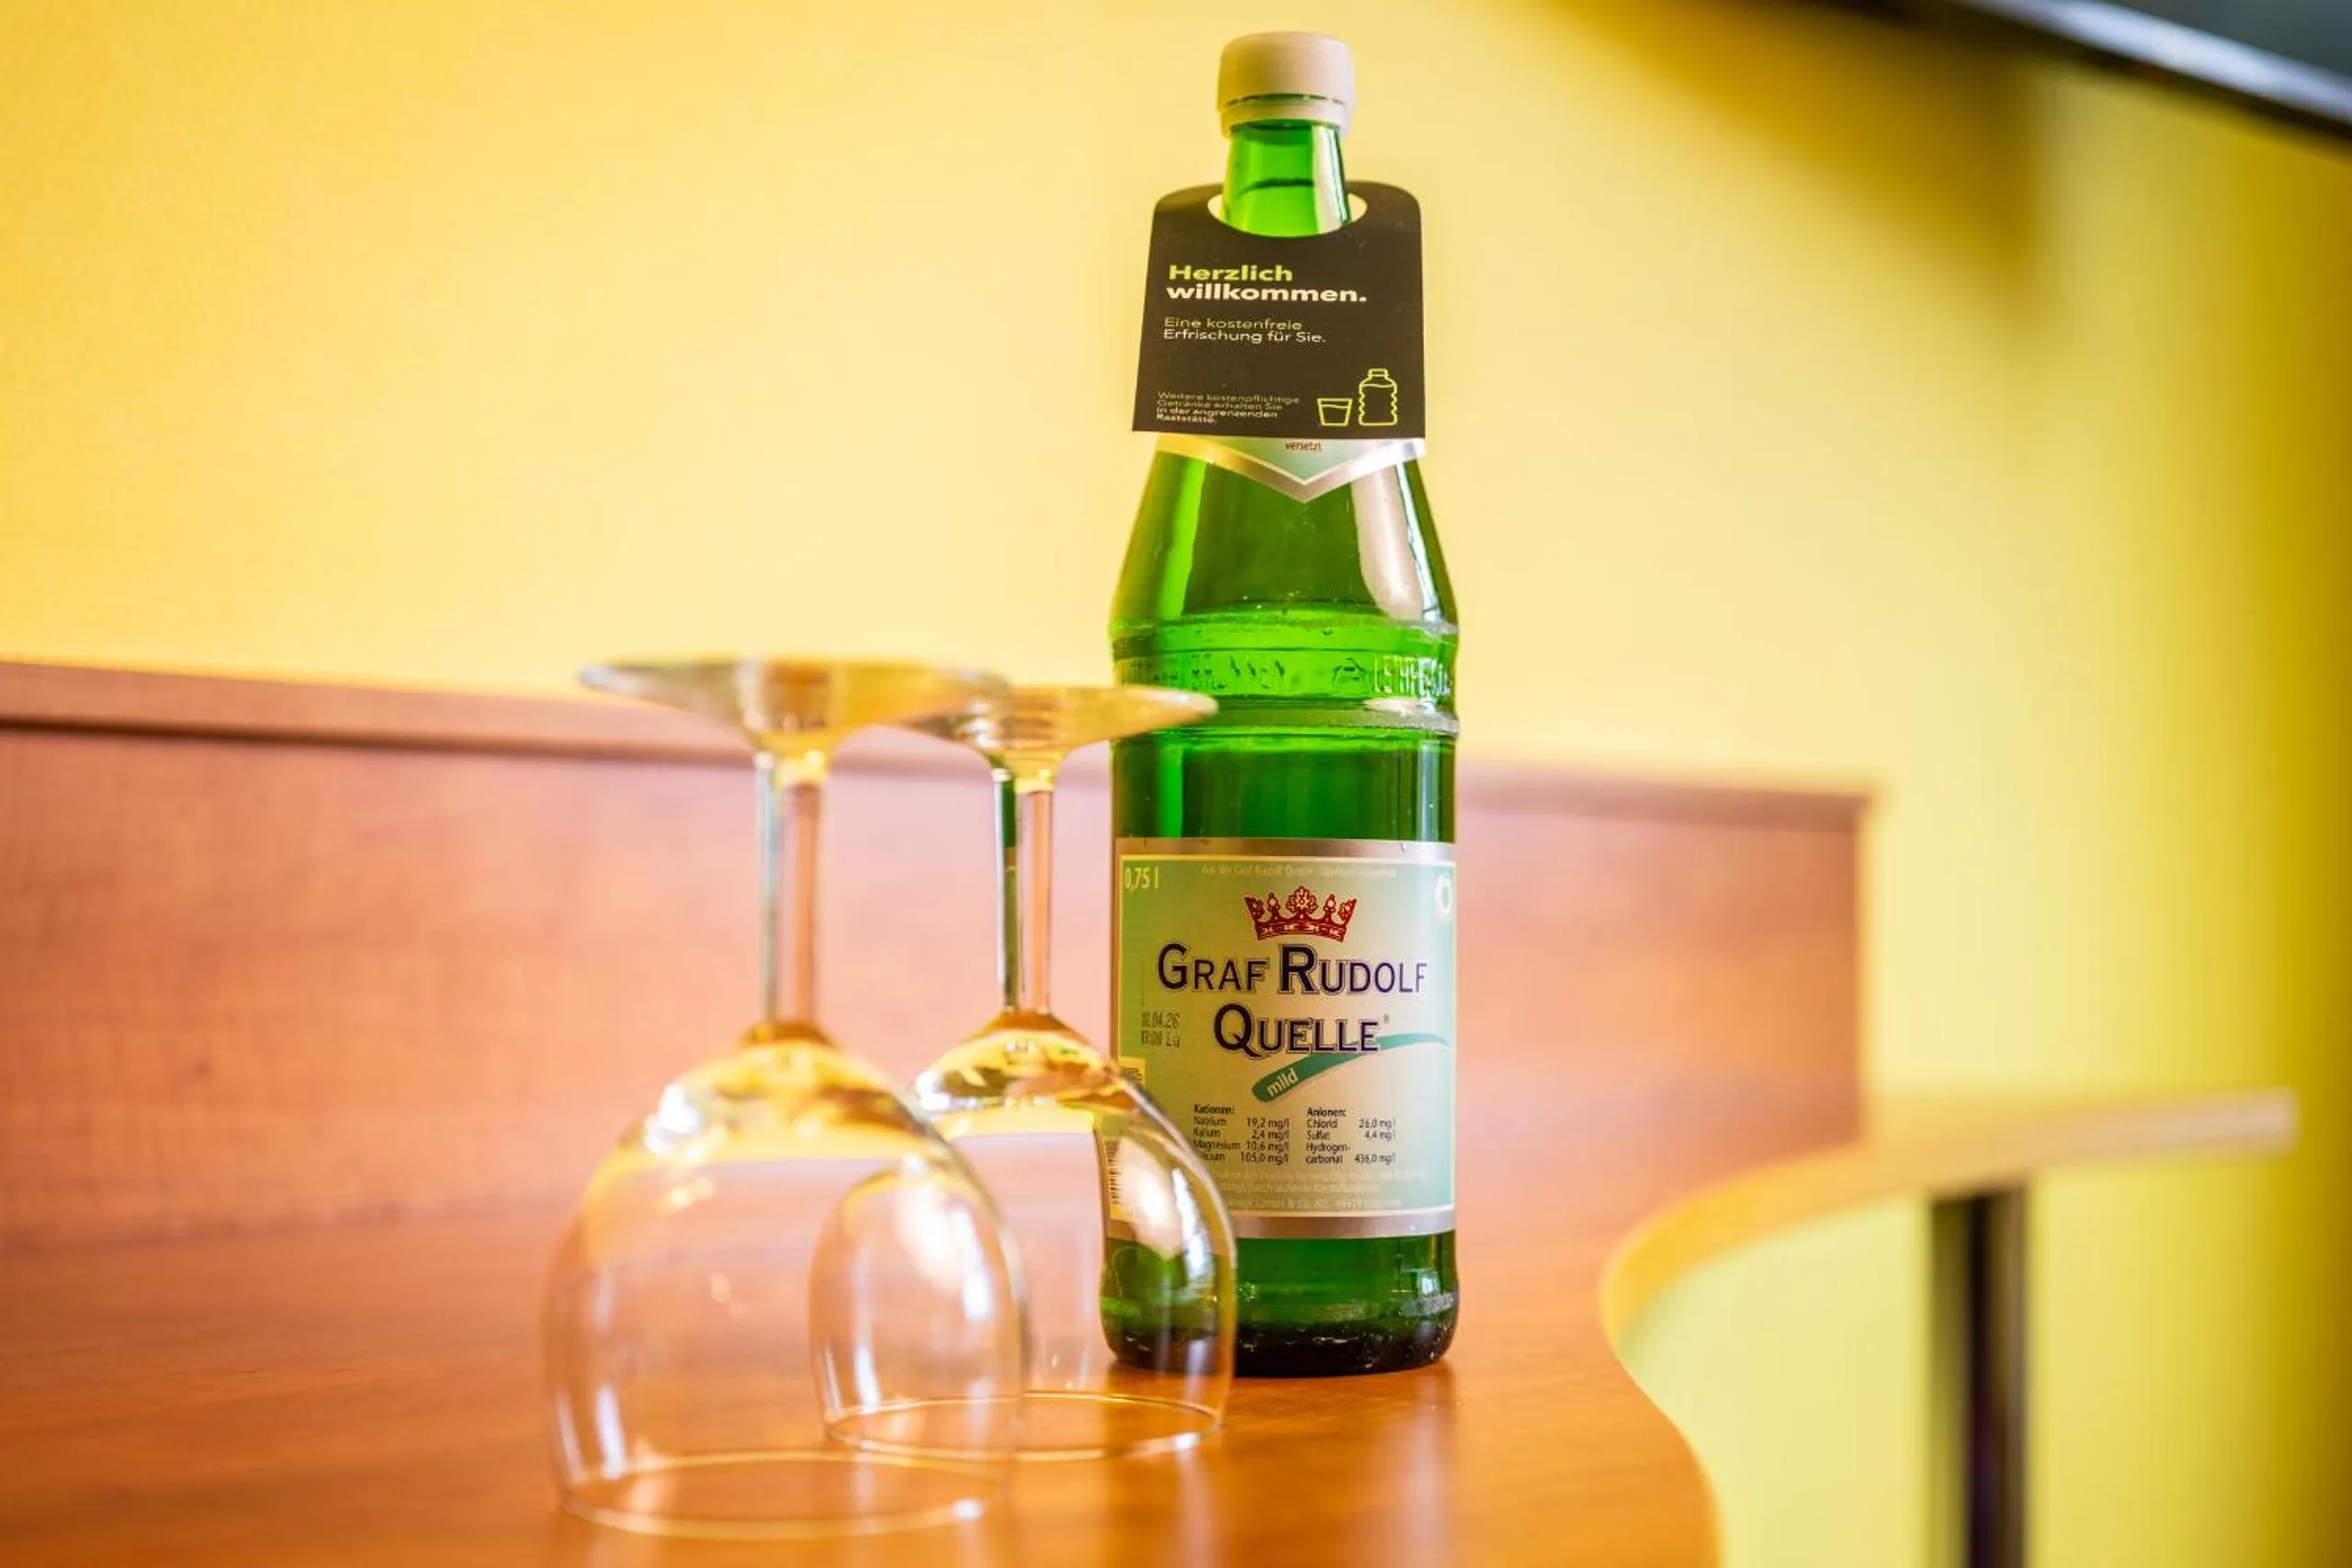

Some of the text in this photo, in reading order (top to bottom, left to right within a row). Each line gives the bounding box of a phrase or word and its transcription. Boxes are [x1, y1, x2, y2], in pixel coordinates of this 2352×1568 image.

[1169, 265, 1294, 281] Herzlich
[1166, 283, 1368, 302] willkommen.
[1164, 317, 1303, 331] Eine kostenfreie
[1163, 329, 1327, 344] Erfrischung für Sie.
[1157, 399, 1211, 409] Getränke
[1214, 401, 1262, 410] erhalten
[1158, 391, 1300, 405] Weitere kostenpflichtige
[1156, 413, 1218, 424] Raststätte.
[1193, 409, 1279, 419] angrenzenden
[1285, 441, 1322, 452] versetzt
[1125, 866, 1151, 891] 0,75
[1157, 942, 1428, 995] GRAF RUDOLF
[1267, 1067, 1299, 1098] mild
[1307, 1107, 1346, 1118] Anionen:
[1193, 1116, 1290, 1131] Natrium 19,2 mg/l
[1306, 1118, 1338, 1129] Chlorid
[1358, 1119, 1377, 1129] 26,0
[1193, 1127, 1290, 1143] Kalium 2,4 mg/l
[1306, 1130, 1330, 1140] Sulfat
[1364, 1131, 1377, 1141] 4,4
[1247, 1141, 1266, 1152] 10,6
[1268, 1141, 1290, 1155] mg/l
[1306, 1142, 1351, 1155] Hydrogen-
[1240, 1152, 1266, 1164] 105,0
[1268, 1153, 1289, 1166] mg/l
[1306, 1154, 1343, 1165] carbonat
